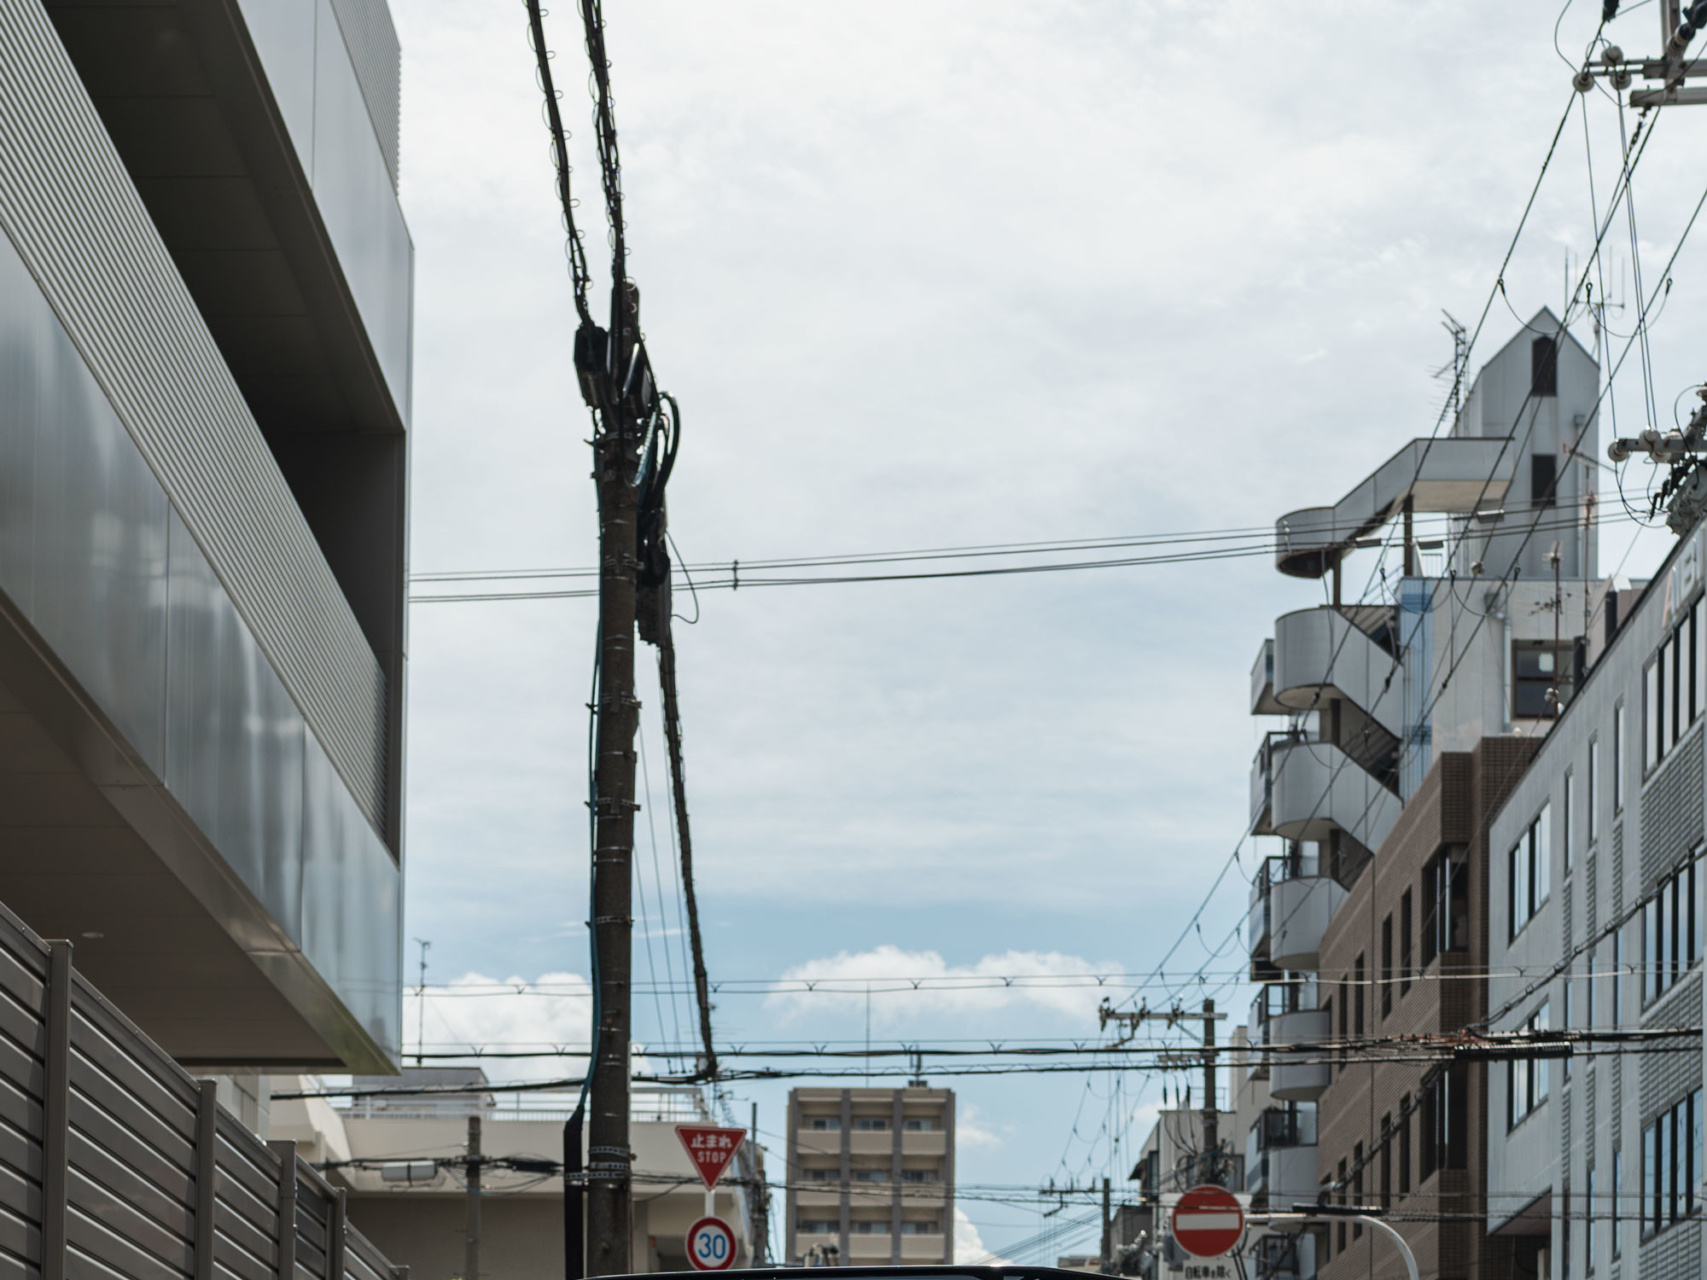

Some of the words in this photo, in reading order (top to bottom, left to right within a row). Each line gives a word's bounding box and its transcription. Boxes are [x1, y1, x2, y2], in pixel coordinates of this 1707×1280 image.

[690, 1133, 732, 1149] 止まれ
[697, 1151, 727, 1164] STOP
[698, 1232, 726, 1260] 30
